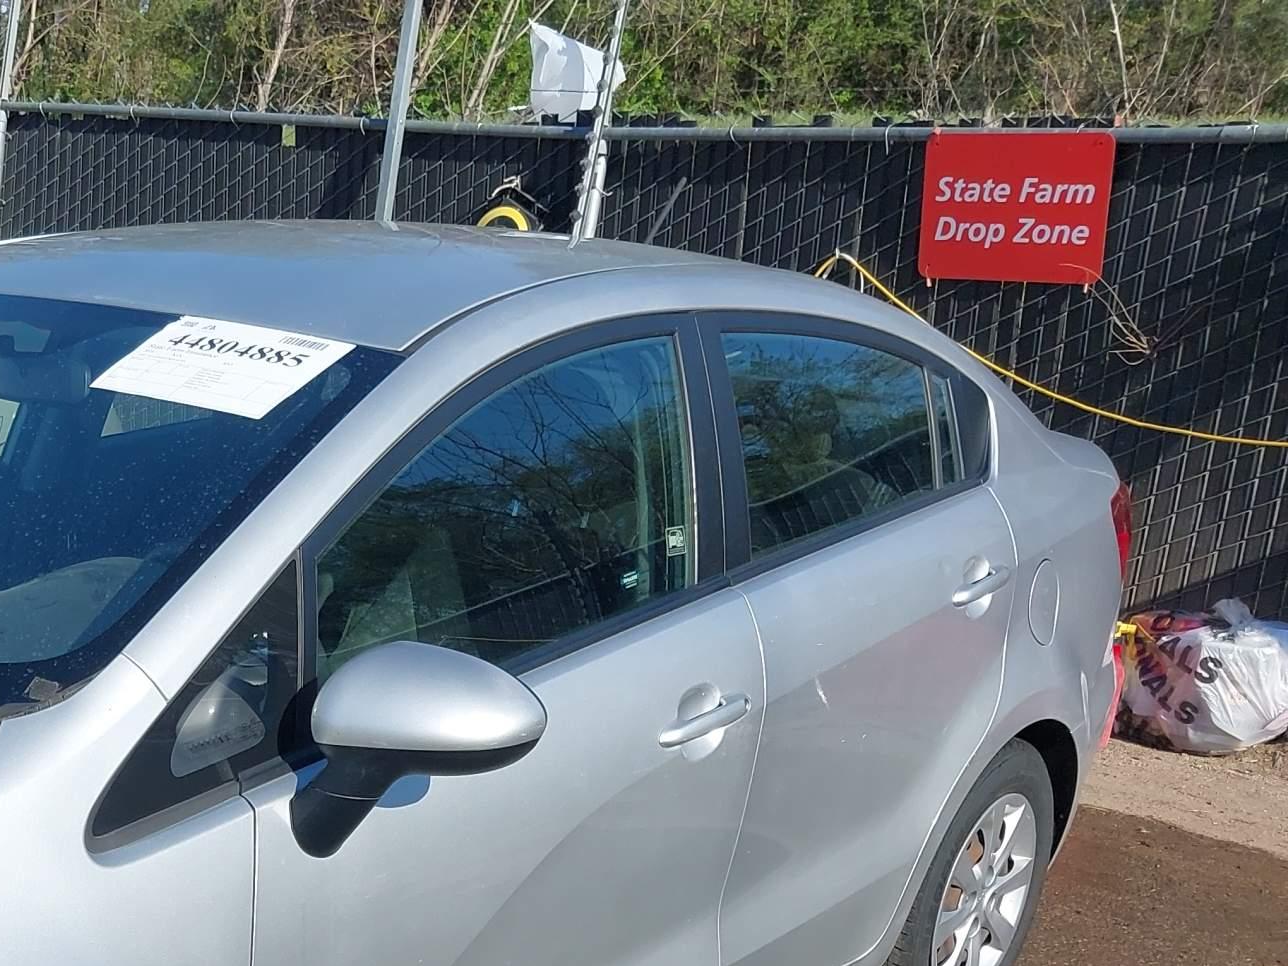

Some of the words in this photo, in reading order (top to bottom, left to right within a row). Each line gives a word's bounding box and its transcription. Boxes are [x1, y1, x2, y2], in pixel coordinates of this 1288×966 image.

[935, 176, 1011, 203] State
[1018, 177, 1096, 205] Farm
[934, 216, 1005, 249] Drop
[1012, 217, 1090, 246] Zone
[167, 333, 311, 368] 44804885
